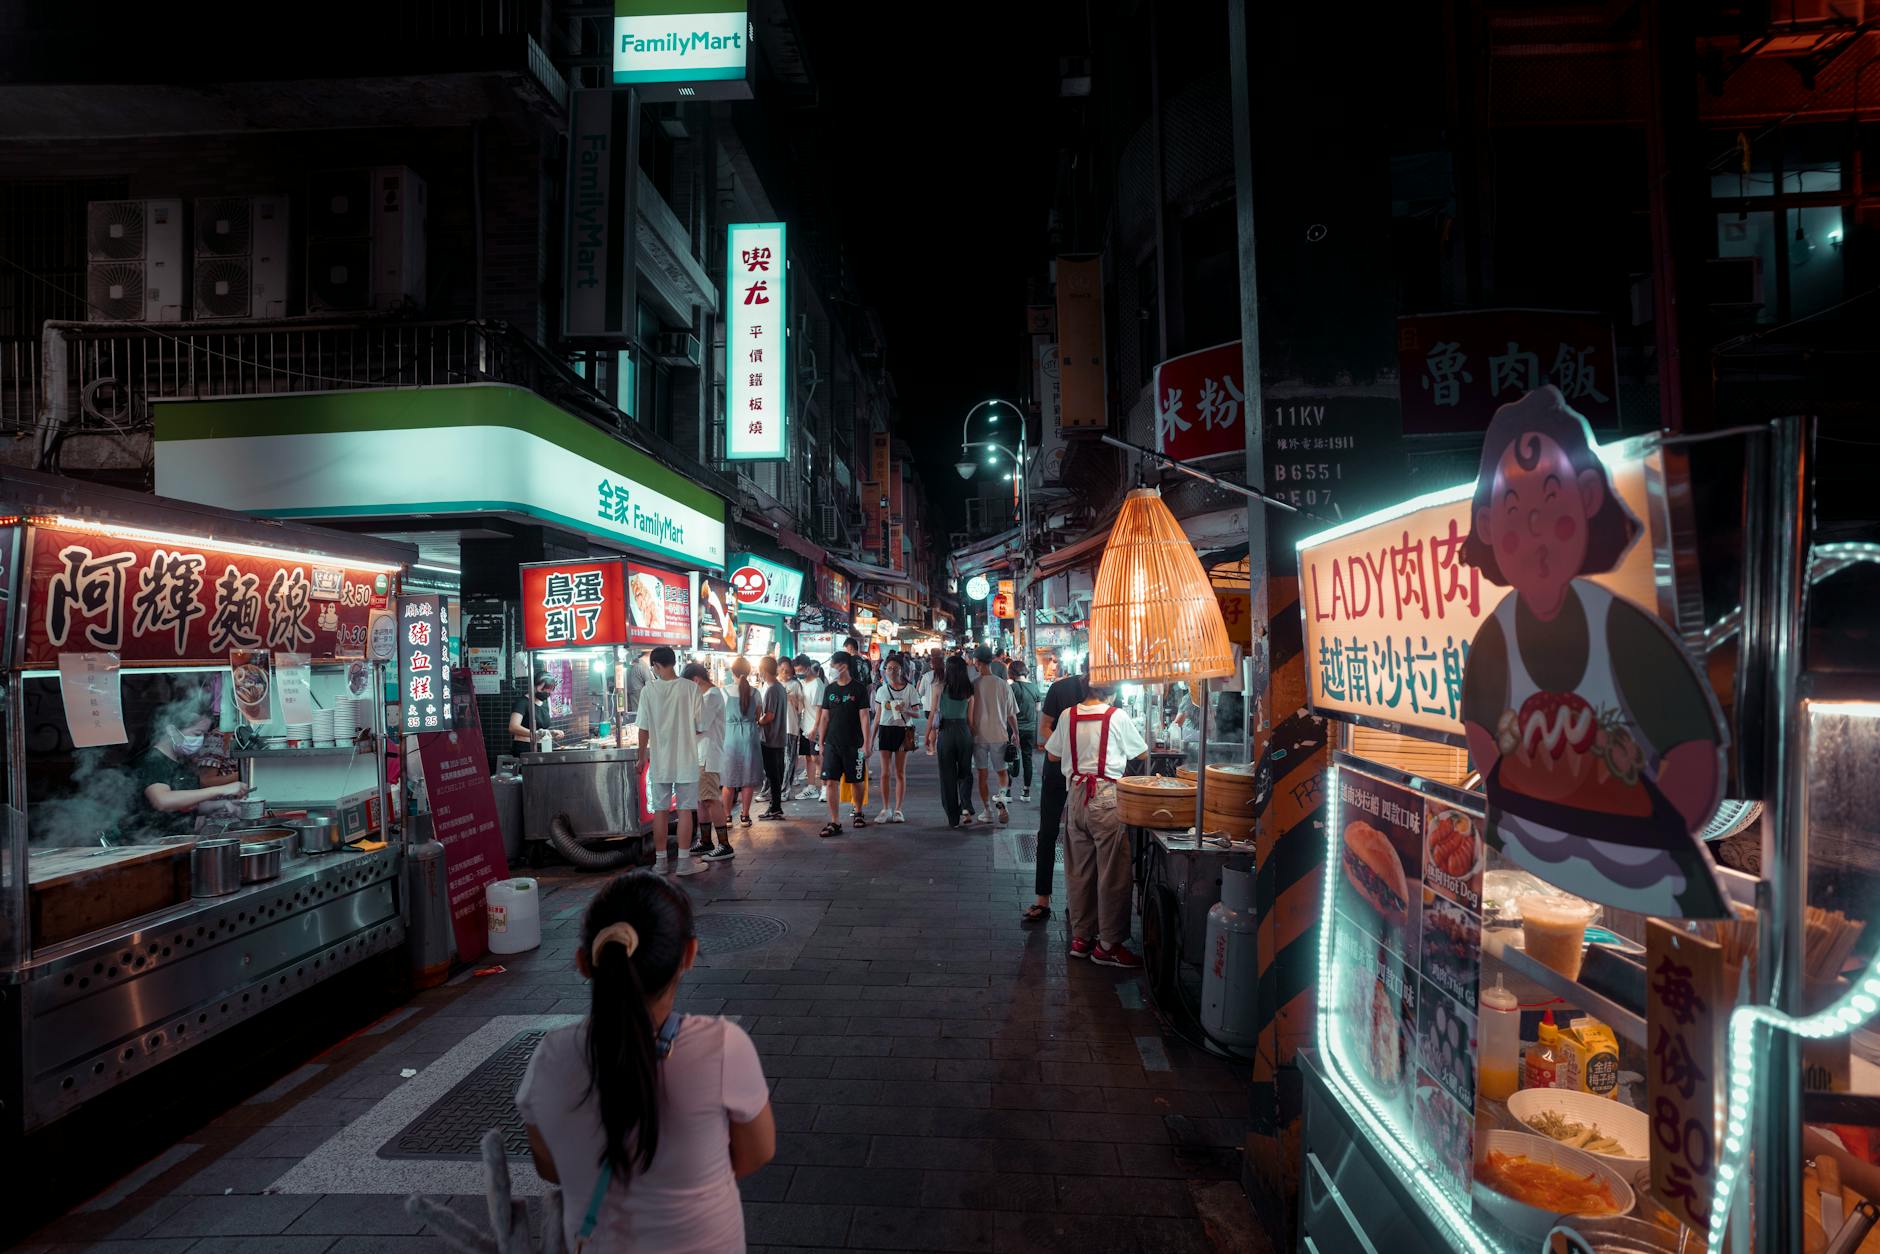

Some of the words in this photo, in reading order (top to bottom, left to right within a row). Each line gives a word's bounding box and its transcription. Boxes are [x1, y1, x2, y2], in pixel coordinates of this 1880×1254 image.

[621, 31, 741, 56] FamilyMart
[575, 134, 607, 289] FamilyMart
[742, 246, 770, 306] 喫尤
[748, 324, 764, 436] 平價鐵板燒
[1421, 341, 1610, 407] 魯肉飯
[1161, 374, 1245, 443] 米粉
[1275, 405, 1325, 426] 11KV
[597, 478, 629, 525] 全家
[633, 503, 684, 545] FamilyMart
[545, 571, 604, 609] 鳥蛋
[1310, 518, 1481, 623] LADY肉肉
[545, 606, 602, 642] 到了
[408, 620, 434, 702] 豬血糕
[407, 716, 420, 727] 35
[425, 715, 437, 727] 25
[1341, 783, 1380, 816] 越南沙拉船
[1381, 799, 1422, 835] 四款口味
[1443, 872, 1460, 894] Hot
[1460, 881, 1479, 908] Dog
[1376, 960, 1415, 1008] 四款口味
